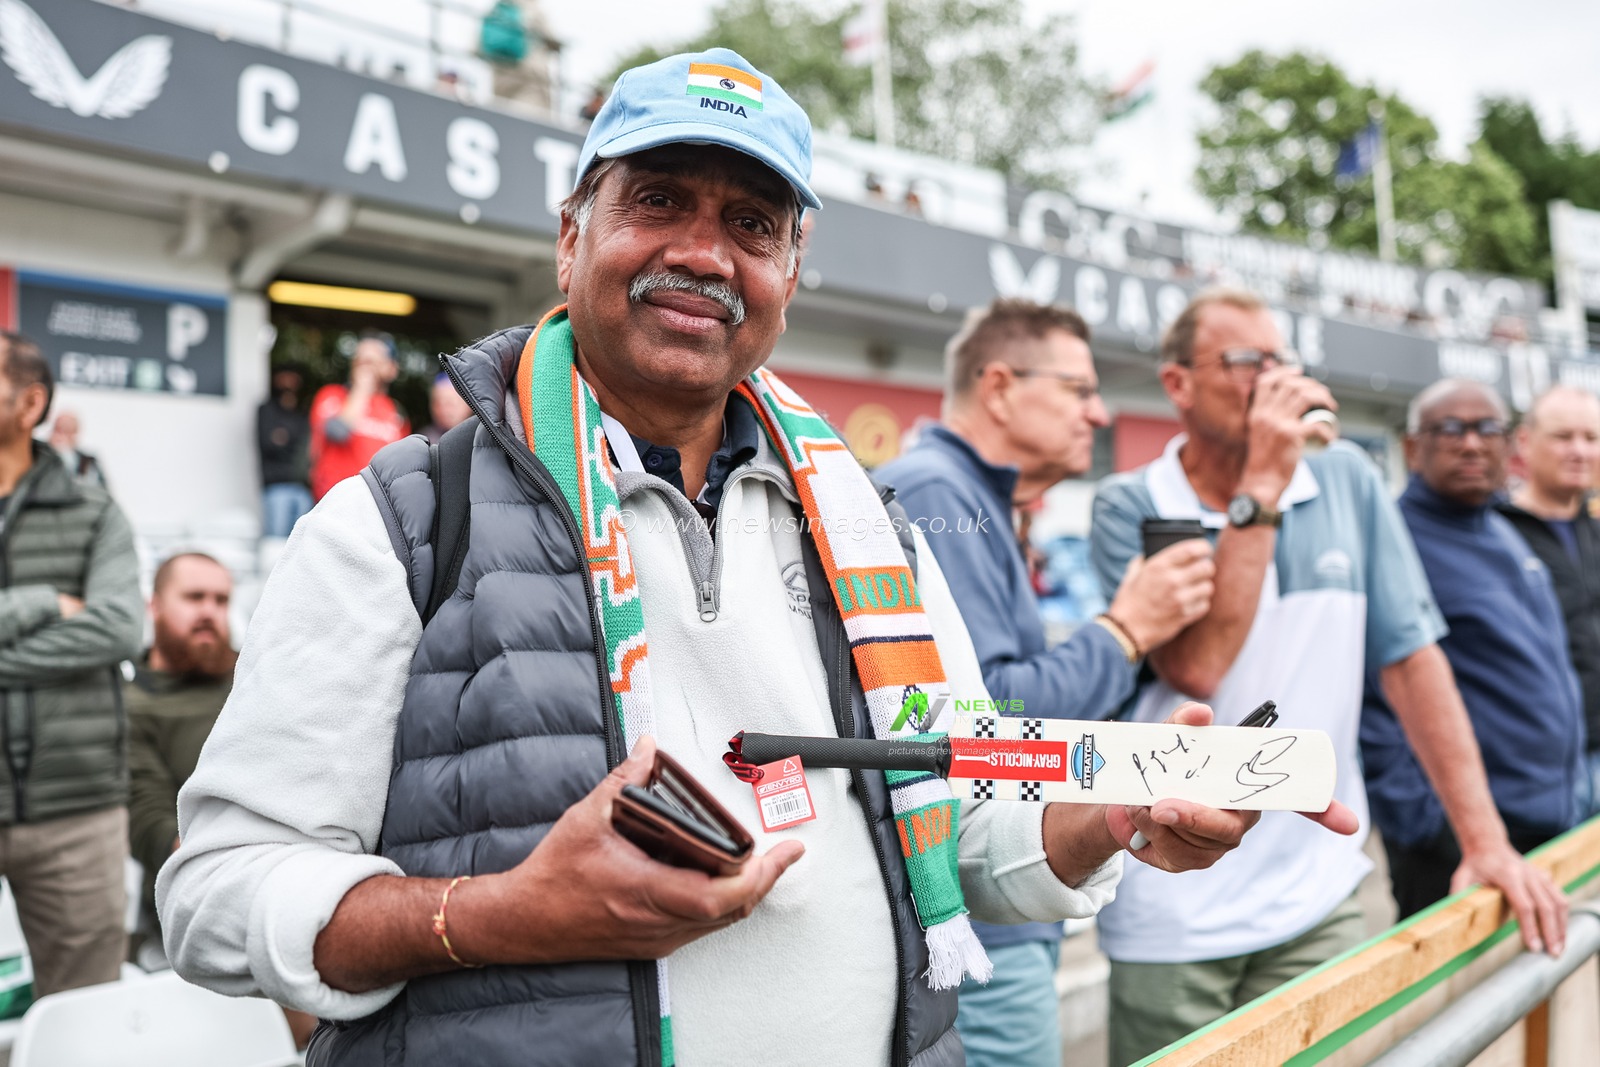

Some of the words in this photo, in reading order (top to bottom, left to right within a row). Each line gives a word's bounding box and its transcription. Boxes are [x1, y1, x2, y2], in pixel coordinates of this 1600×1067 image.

[700, 97, 748, 119] INDIA
[990, 752, 1061, 769] GRAY-NICOLLS
[1083, 736, 1092, 787] STRATOS
